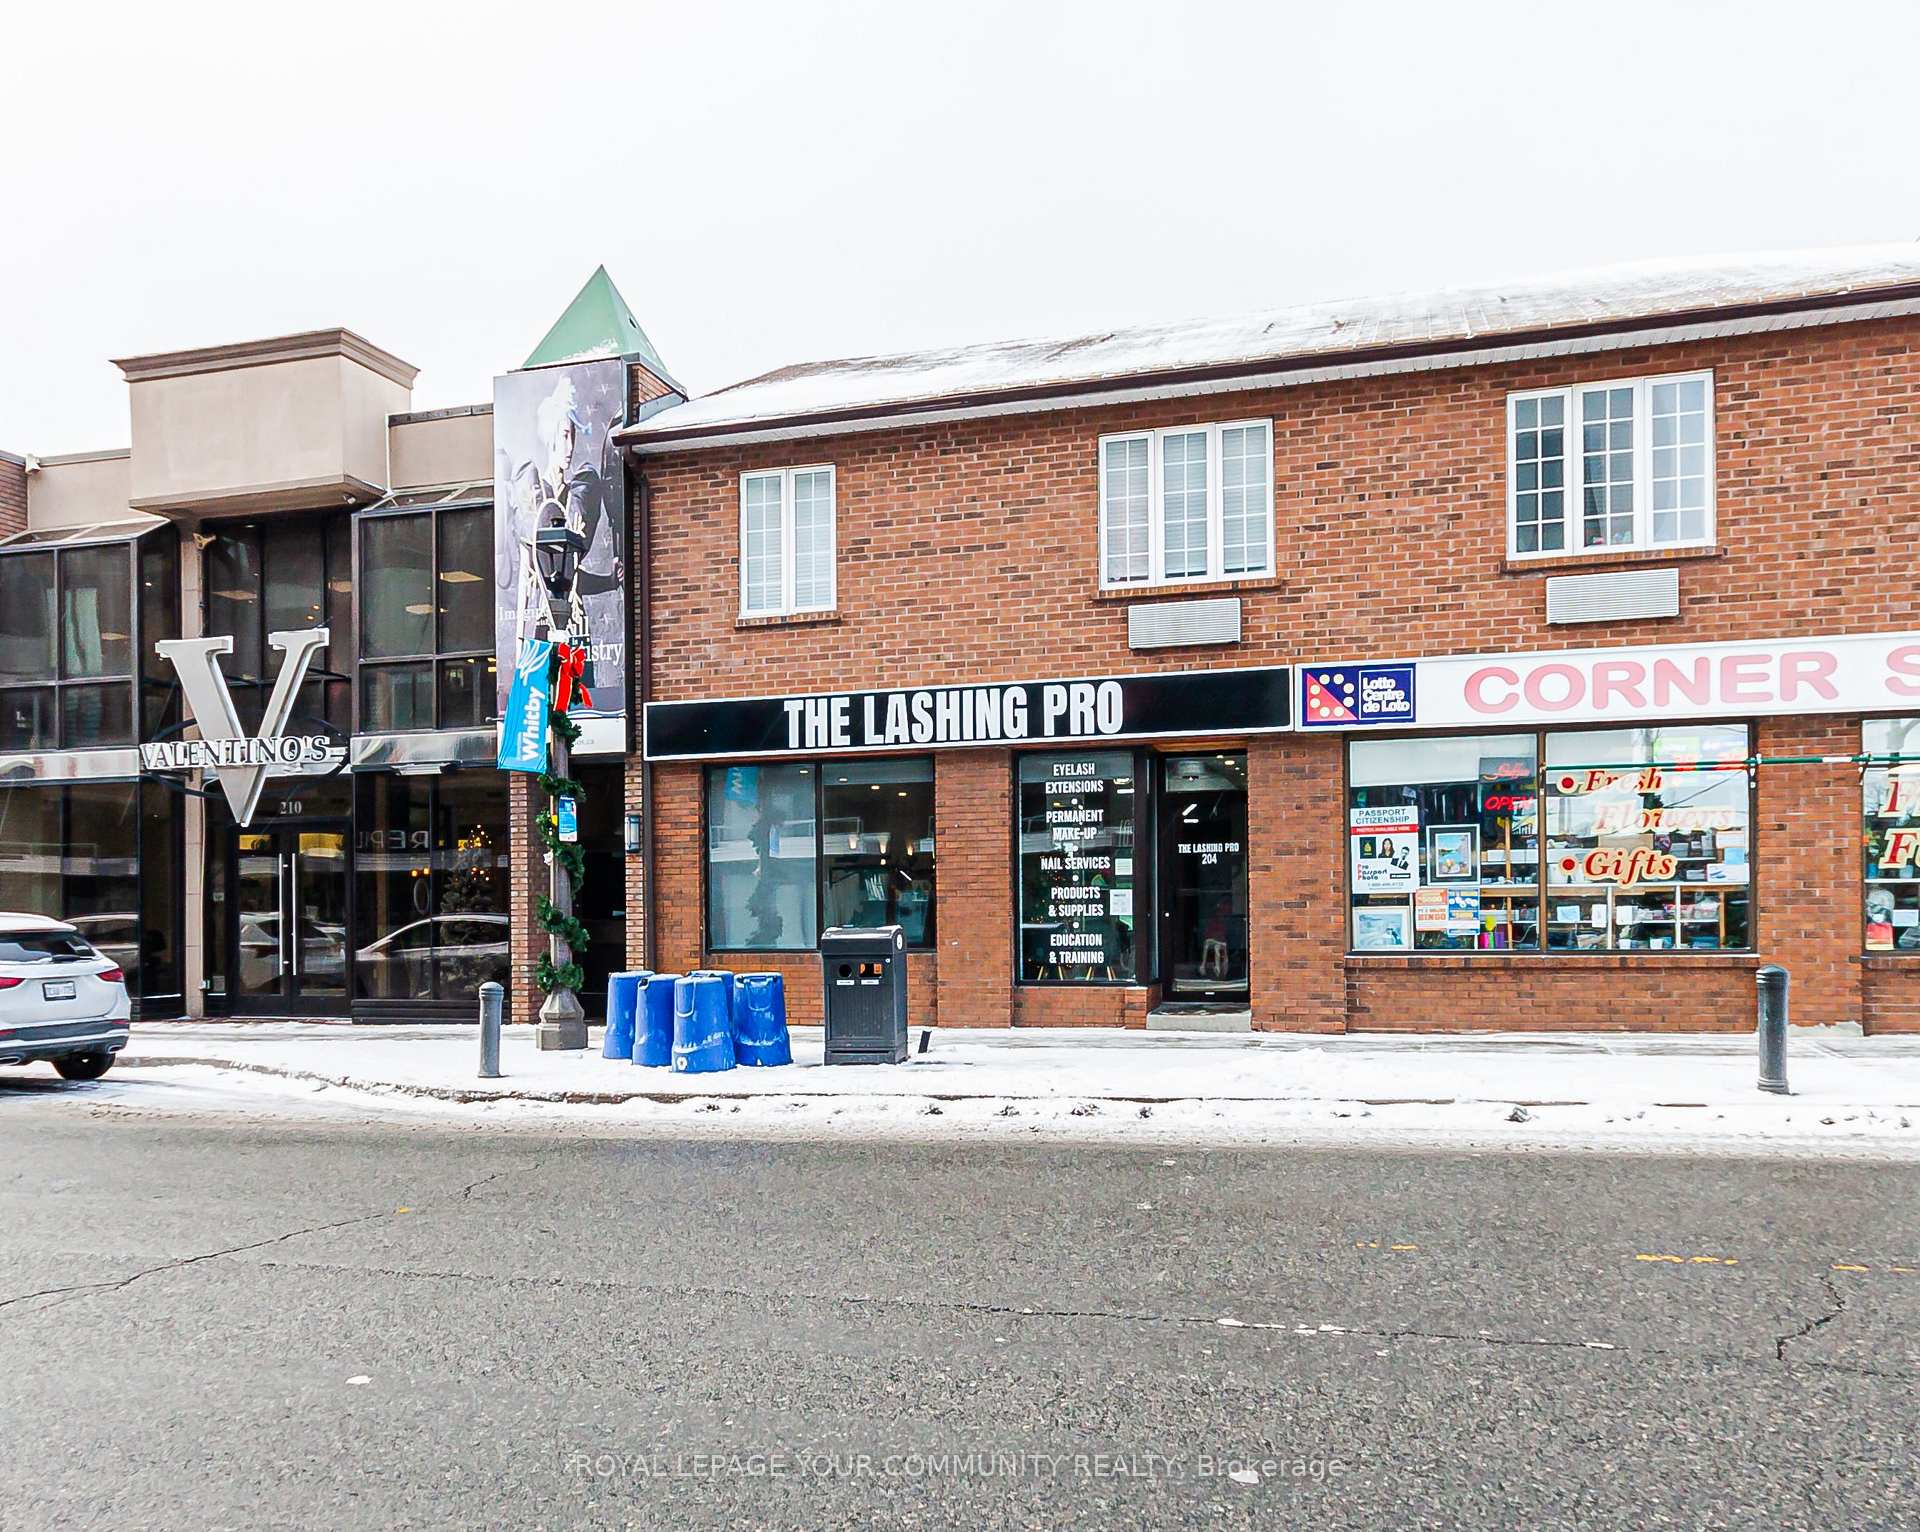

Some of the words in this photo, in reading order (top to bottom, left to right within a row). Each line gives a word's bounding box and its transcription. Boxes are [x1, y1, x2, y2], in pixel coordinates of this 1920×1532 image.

[1464, 651, 1839, 714] CORNER
[1363, 688, 1405, 702] Centre
[1363, 701, 1380, 713] de
[1381, 700, 1410, 713] Loto
[784, 698, 850, 749] THE
[864, 686, 1027, 747] LASHING
[1042, 681, 1124, 736] PRO
[155, 628, 329, 827] V
[521, 685, 546, 761] Whitby
[139, 734, 330, 769] VALENTINO'S
[1053, 763, 1095, 776] EYELASH
[1045, 779, 1104, 794] EXTENSIONS
[280, 802, 302, 814] 210
[1485, 795, 1534, 811] OPEN
[1046, 809, 1104, 823] PERMANENT
[1359, 808, 1406, 817] PASSPORT
[1356, 816, 1410, 825] CITIZENSHIP
[1053, 827, 1097, 841] MAKE-UP
[1178, 844, 1191, 853] THE
[1193, 843, 1223, 853] LASHING
[1225, 842, 1240, 852] PRO
[1041, 858, 1063, 870] NAIL
[1065, 856, 1110, 870] SERVICES
[1202, 853, 1217, 865] 204
[1585, 850, 1674, 885] Gifts
[1051, 887, 1101, 900] PRODUCTS
[1048, 905, 1057, 917] &
[1059, 904, 1104, 917] SUPPLIES
[1050, 933, 1102, 947] EDUCATION
[1049, 952, 1057, 964] &
[1060, 951, 1104, 964] TRAINING
